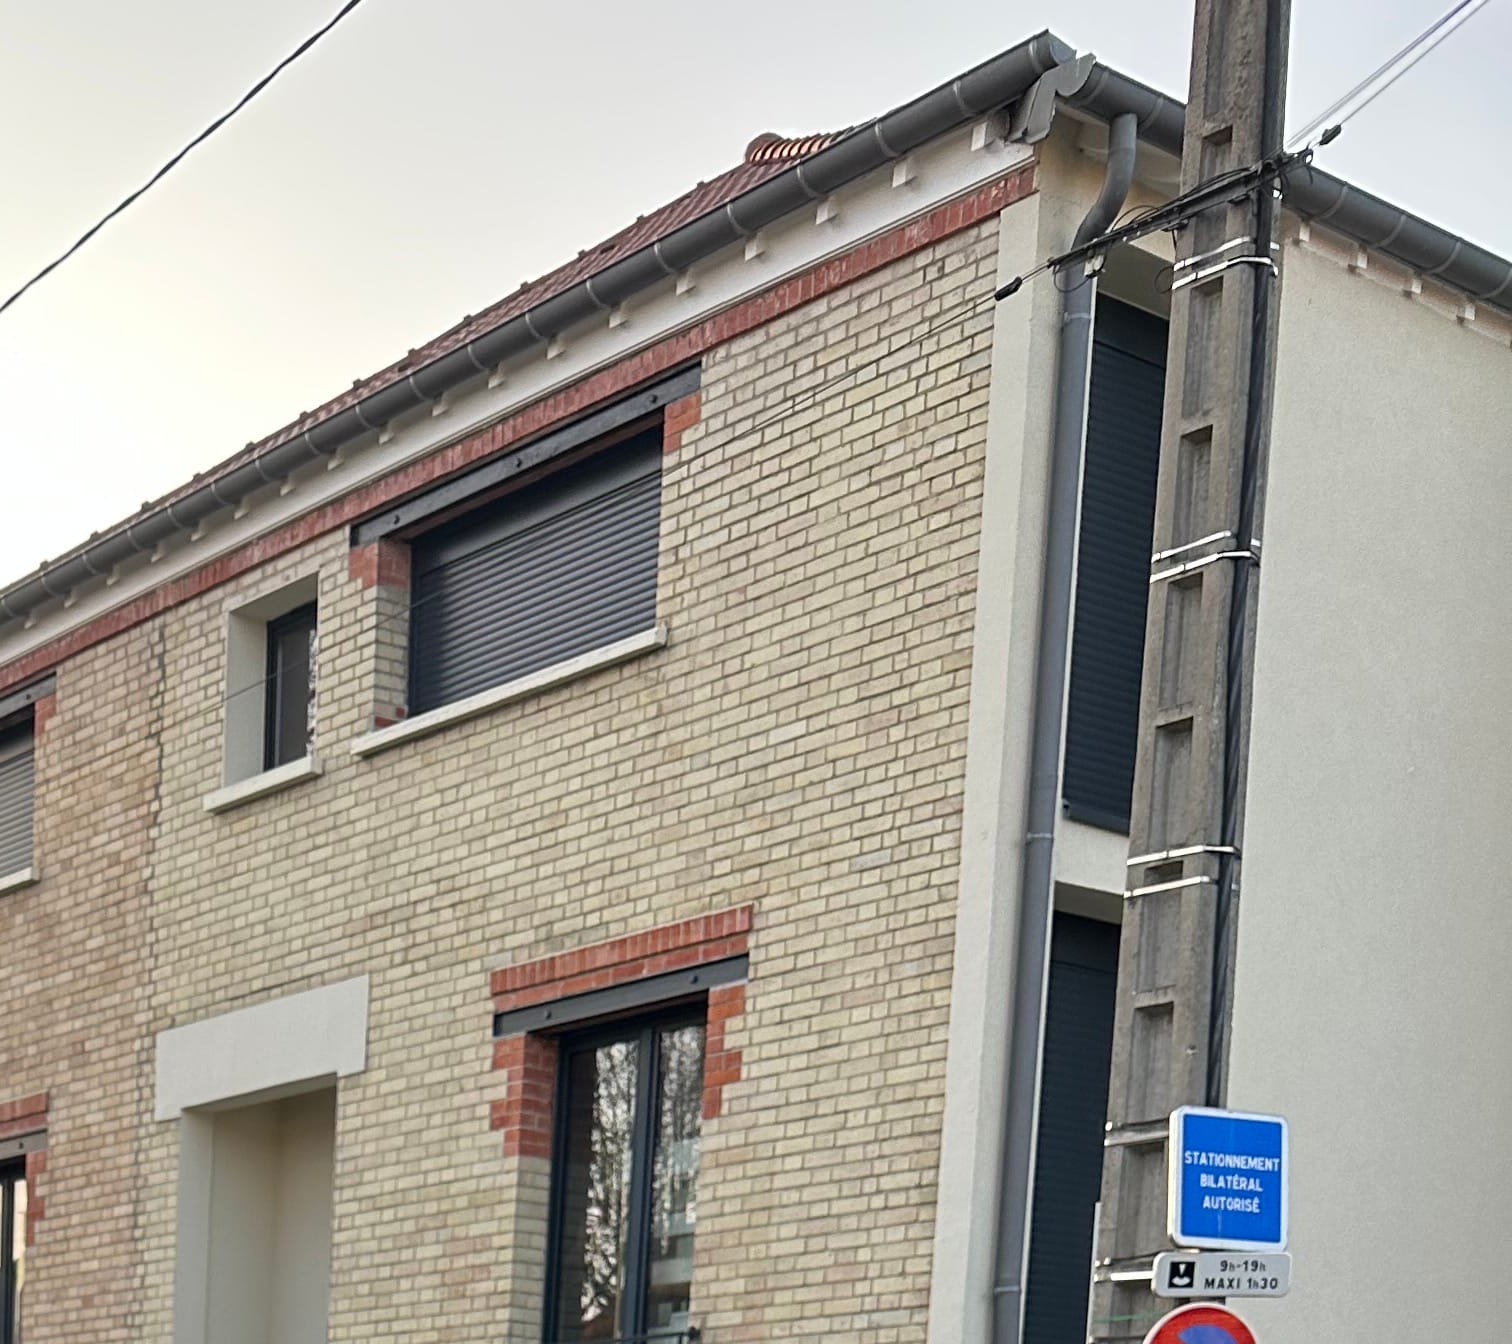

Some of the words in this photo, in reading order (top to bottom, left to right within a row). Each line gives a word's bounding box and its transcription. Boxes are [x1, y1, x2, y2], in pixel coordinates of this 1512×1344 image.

[1184, 1151, 1280, 1172] STATIONNEMENT
[1200, 1173, 1264, 1192] BILATÉRAL
[1203, 1195, 1260, 1213] AUTORISÉ
[1203, 1278, 1241, 1290] MAXI
[1247, 1277, 1279, 1290] 1h30
